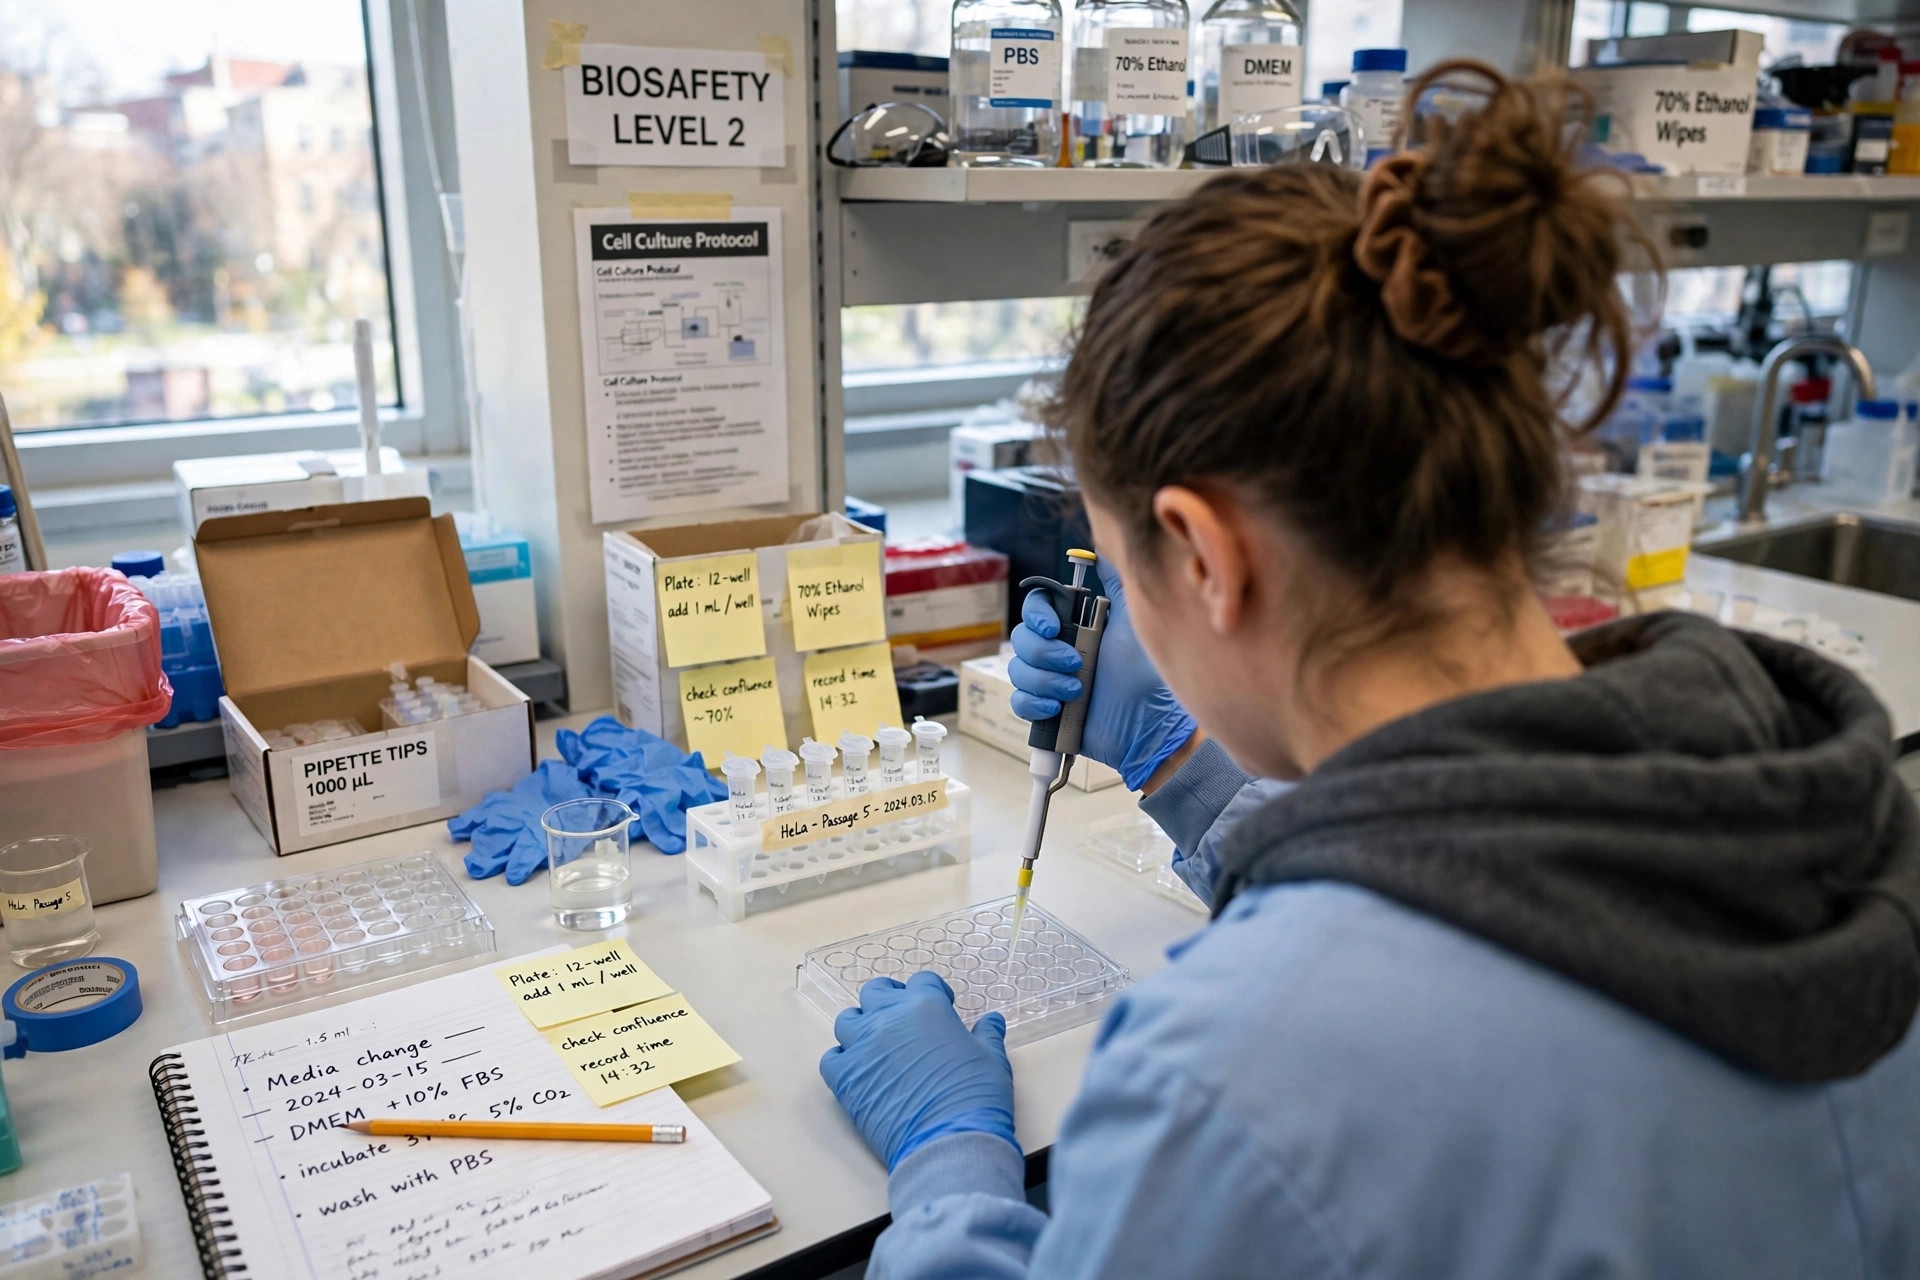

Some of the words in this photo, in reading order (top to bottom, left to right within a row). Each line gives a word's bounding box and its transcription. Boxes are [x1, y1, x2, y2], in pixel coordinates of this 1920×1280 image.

[1004, 47, 1039, 65] PBS
[1115, 56, 1144, 71] 70%
[1148, 56, 1186, 72] Ethanol
[1244, 58, 1291, 75] DMEM
[581, 64, 770, 102] BIOSAFETY
[1655, 90, 1690, 113] 70%
[1695, 90, 1751, 114] Ethanol
[613, 113, 718, 146] LEVEL
[728, 117, 745, 147] 2
[1657, 120, 1707, 149] Wipes
[602, 232, 631, 250] Cell
[635, 231, 692, 250] Culture
[695, 230, 759, 249] Protocol
[664, 575, 701, 592] Plate:
[708, 568, 751, 586] 12-well
[798, 583, 821, 599] 70%
[826, 578, 864, 596] Ethanol
[668, 602, 689, 618] add
[695, 601, 699, 615] 1
[704, 599, 721, 614] mL
[734, 594, 754, 610] well
[806, 603, 841, 620] Wipes
[686, 685, 718, 702] check
[722, 677, 773, 696] confluence
[813, 672, 846, 688] record
[851, 667, 876, 680] time
[819, 692, 858, 711] 14:32
[693, 705, 734, 724] ~70%
[304, 749, 382, 778] PIPETTE
[386, 740, 428, 761] TIPS
[306, 776, 347, 797] 1000
[352, 772, 374, 792] µL
[780, 820, 809, 839] HeLa
[822, 810, 859, 830] Passage
[863, 804, 871, 819] 5
[884, 790, 938, 813] 2024.03.15
[508, 968, 558, 987] Plate:
[566, 950, 621, 973] 12-well
[523, 987, 551, 1002] add
[557, 982, 565, 992] 1
[571, 977, 594, 989] mL
[610, 964, 638, 979] well
[305, 1032, 328, 1046] 1.5
[561, 1030, 606, 1051] check
[612, 1007, 689, 1036] confluence
[267, 1064, 340, 1092] Media
[356, 1038, 433, 1067] change
[580, 1048, 630, 1072] record
[636, 1036, 674, 1053] time
[600, 1060, 656, 1085] 14:32
[286, 1061, 428, 1112] 2024-03-15
[290, 1107, 366, 1142] DMEM
[387, 1082, 448, 1111] +10%
[461, 1066, 504, 1091] FBS
[299, 1141, 391, 1179] incubate
[489, 1096, 523, 1119] 5%
[319, 1187, 378, 1217] wash
[391, 1169, 439, 1194] with
[450, 1149, 494, 1176] PBS
